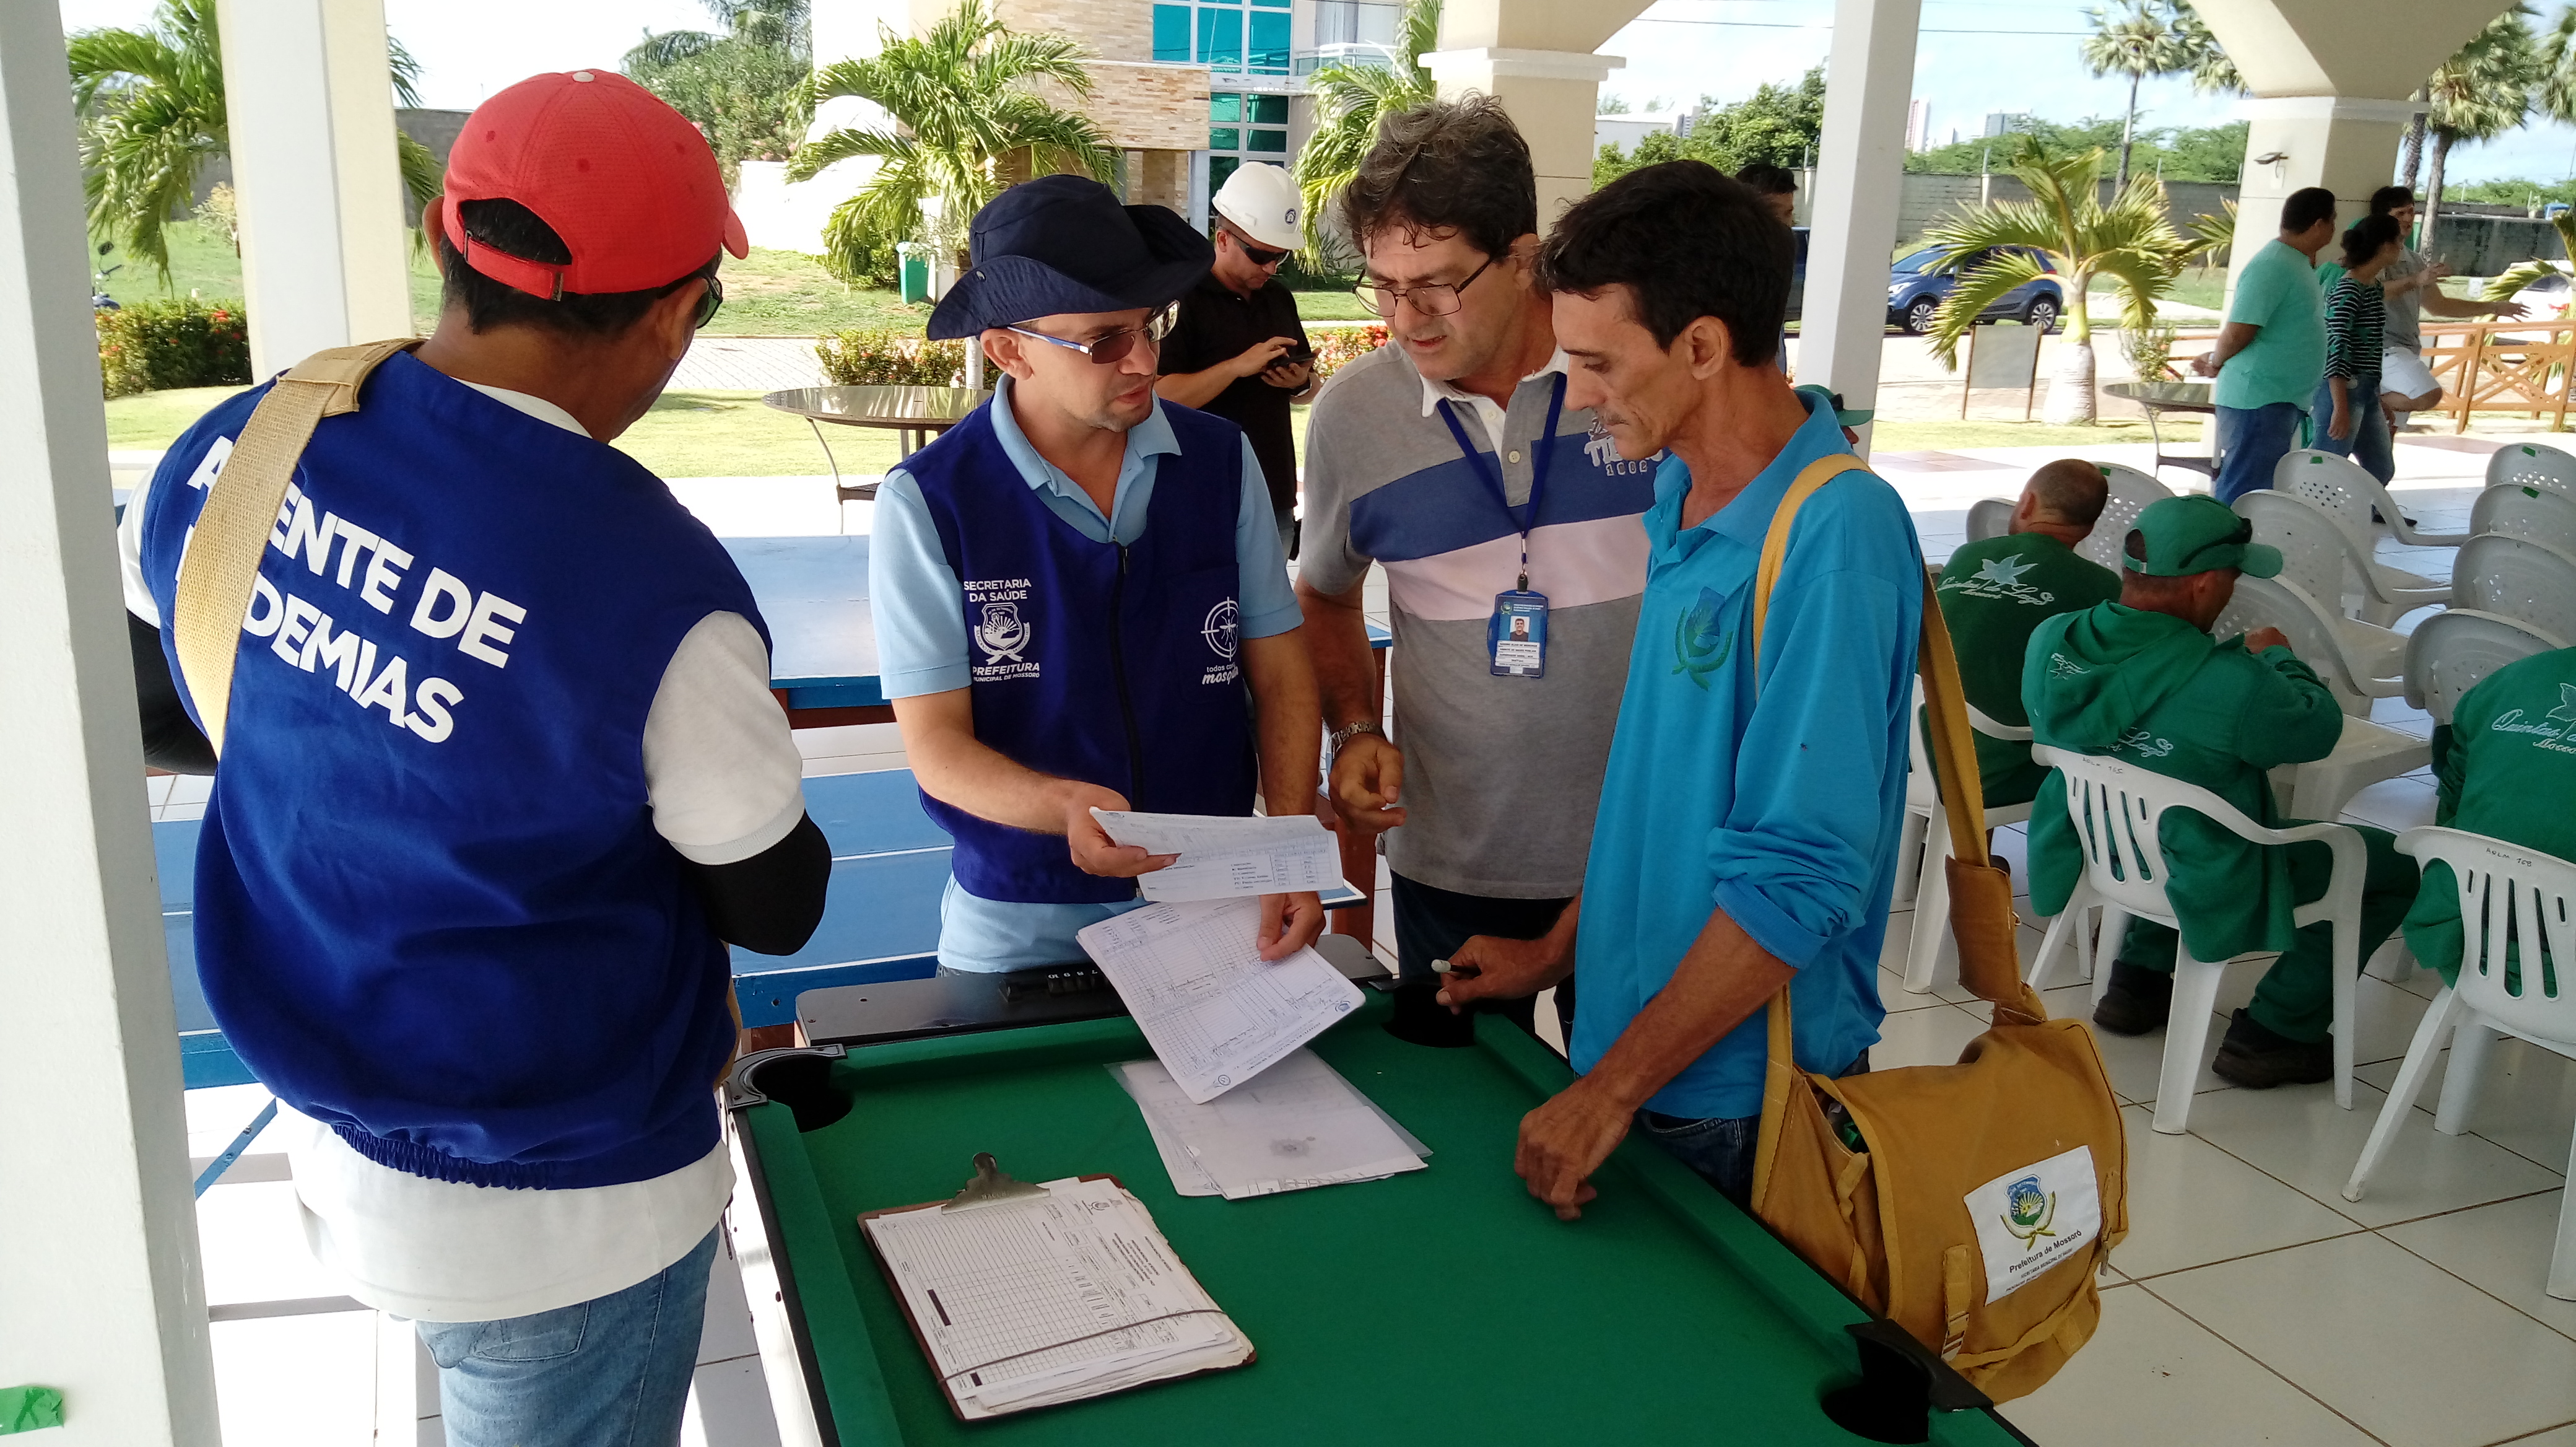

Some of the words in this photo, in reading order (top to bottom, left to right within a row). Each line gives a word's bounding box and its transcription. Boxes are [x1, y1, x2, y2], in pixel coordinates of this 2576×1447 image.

[186, 435, 414, 615] AENTE
[409, 566, 527, 669] DE
[964, 578, 1032, 591] SECRETARIA
[969, 592, 987, 603] DA
[990, 589, 1028, 601] SAÚDE
[972, 662, 1040, 676] PREFEITURA
[1206, 665, 1225, 673] todos
[2009, 1251, 2043, 1274] Prefeitura
[2044, 1246, 2053, 1254] de
[2053, 1229, 2082, 1249] Mossoró
